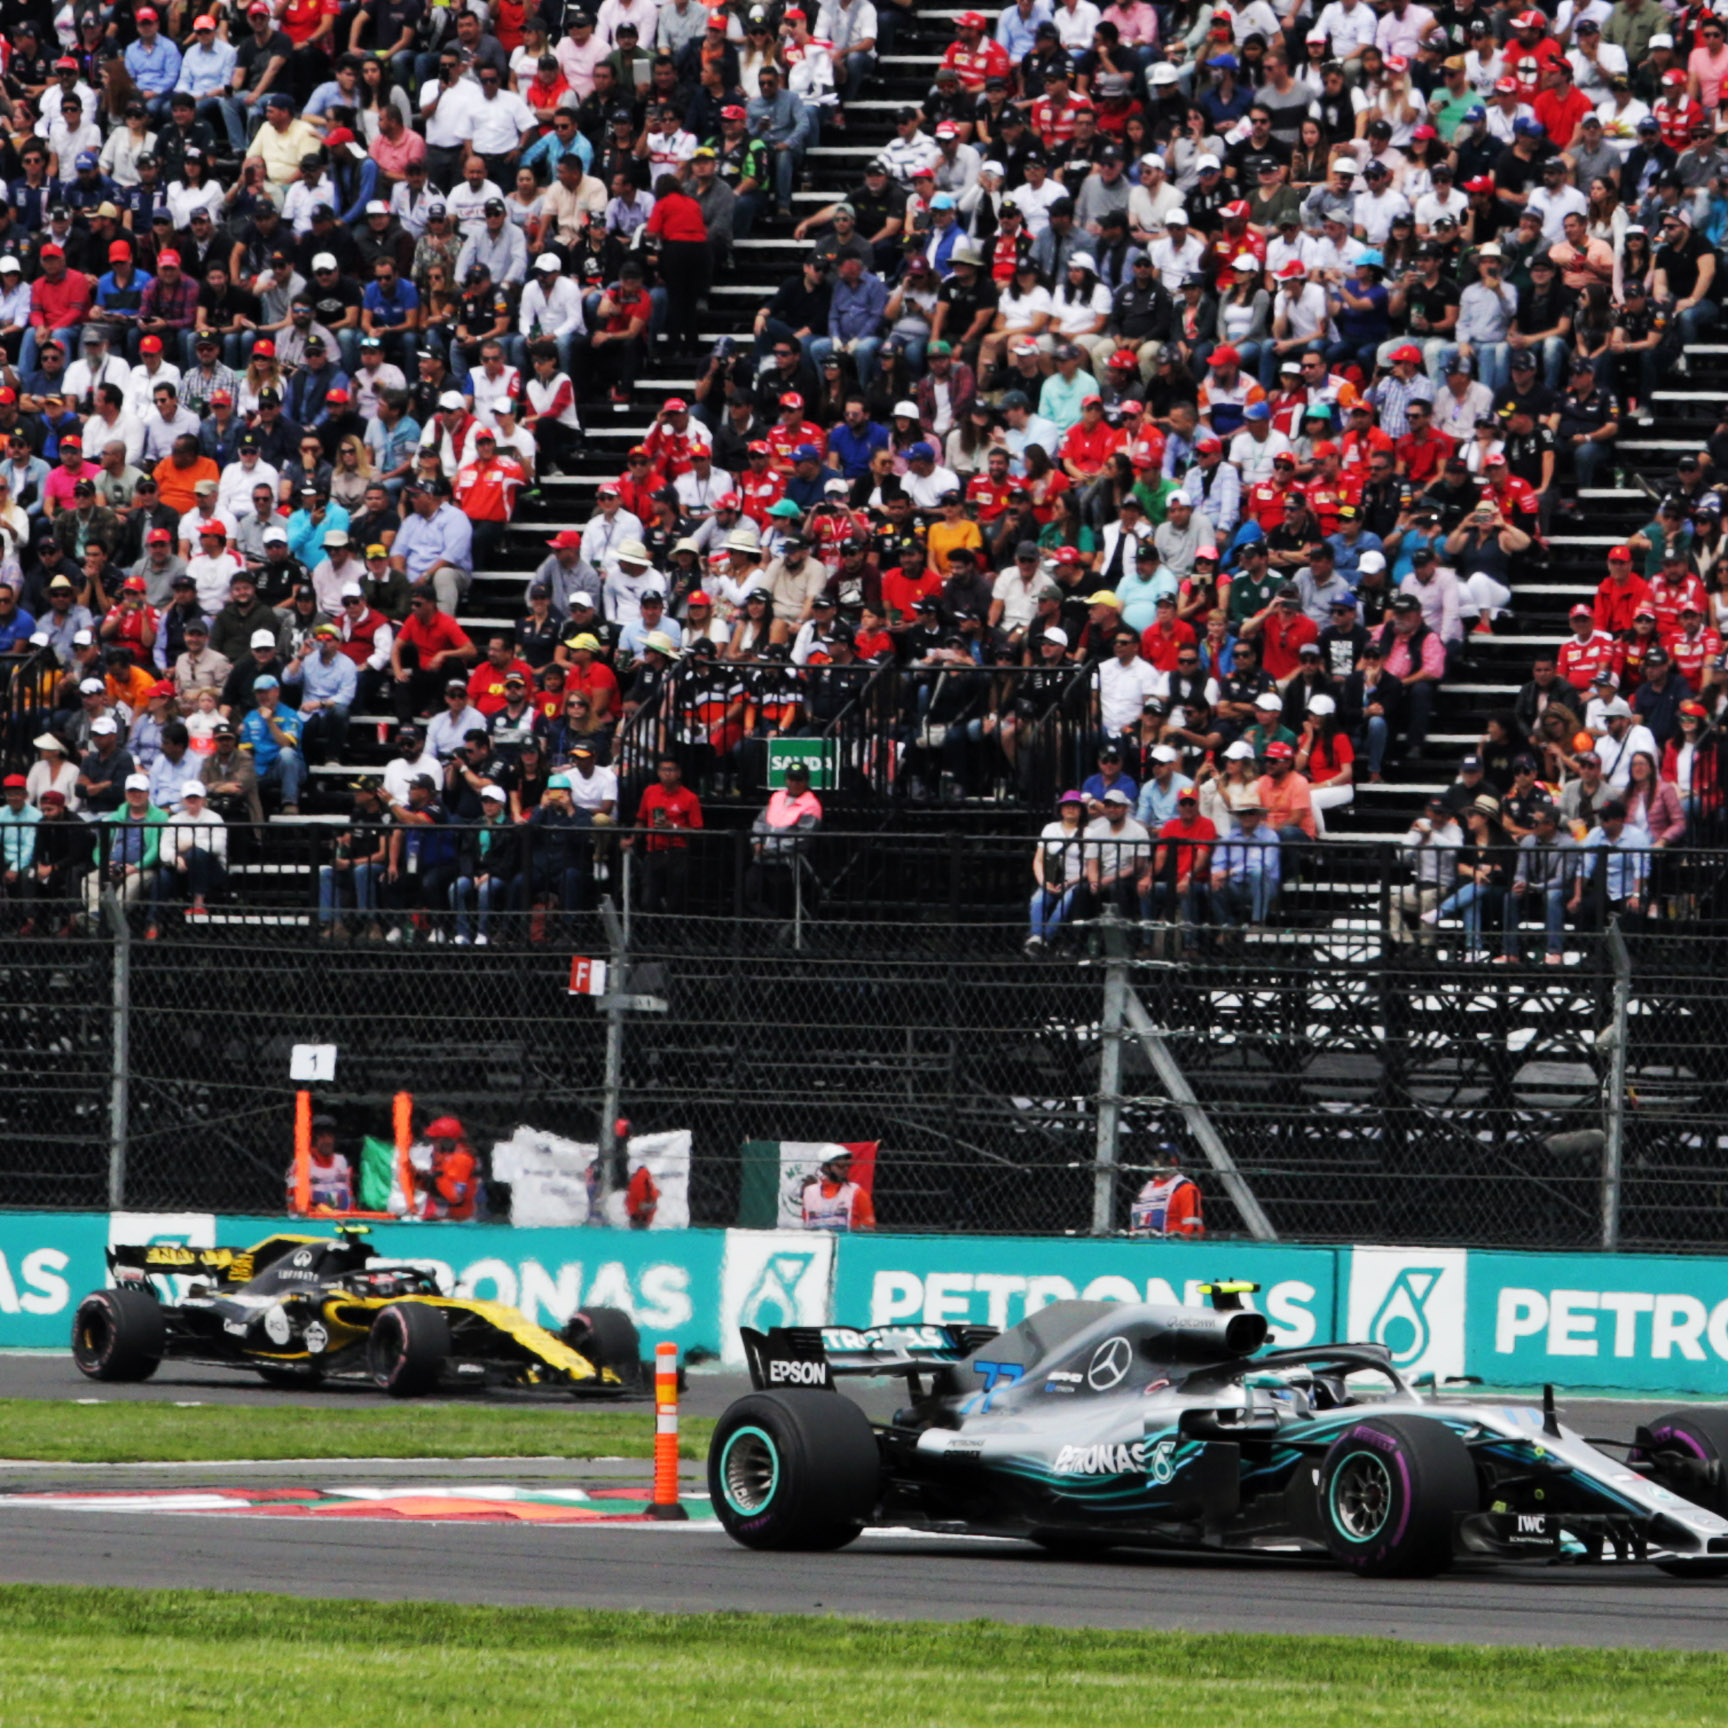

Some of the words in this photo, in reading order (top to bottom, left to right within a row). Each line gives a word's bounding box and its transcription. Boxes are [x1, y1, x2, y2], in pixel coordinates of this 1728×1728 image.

[576, 962, 590, 988] F
[309, 1052, 319, 1069] 1
[871, 1271, 1316, 1347] PETS
[822, 1324, 945, 1351] TROAS
[770, 1360, 826, 1385] EPSON
[960, 1360, 1025, 1415] 77
[1053, 1442, 1146, 1474] PETRONAS
[1517, 1514, 1546, 1535] IWC
